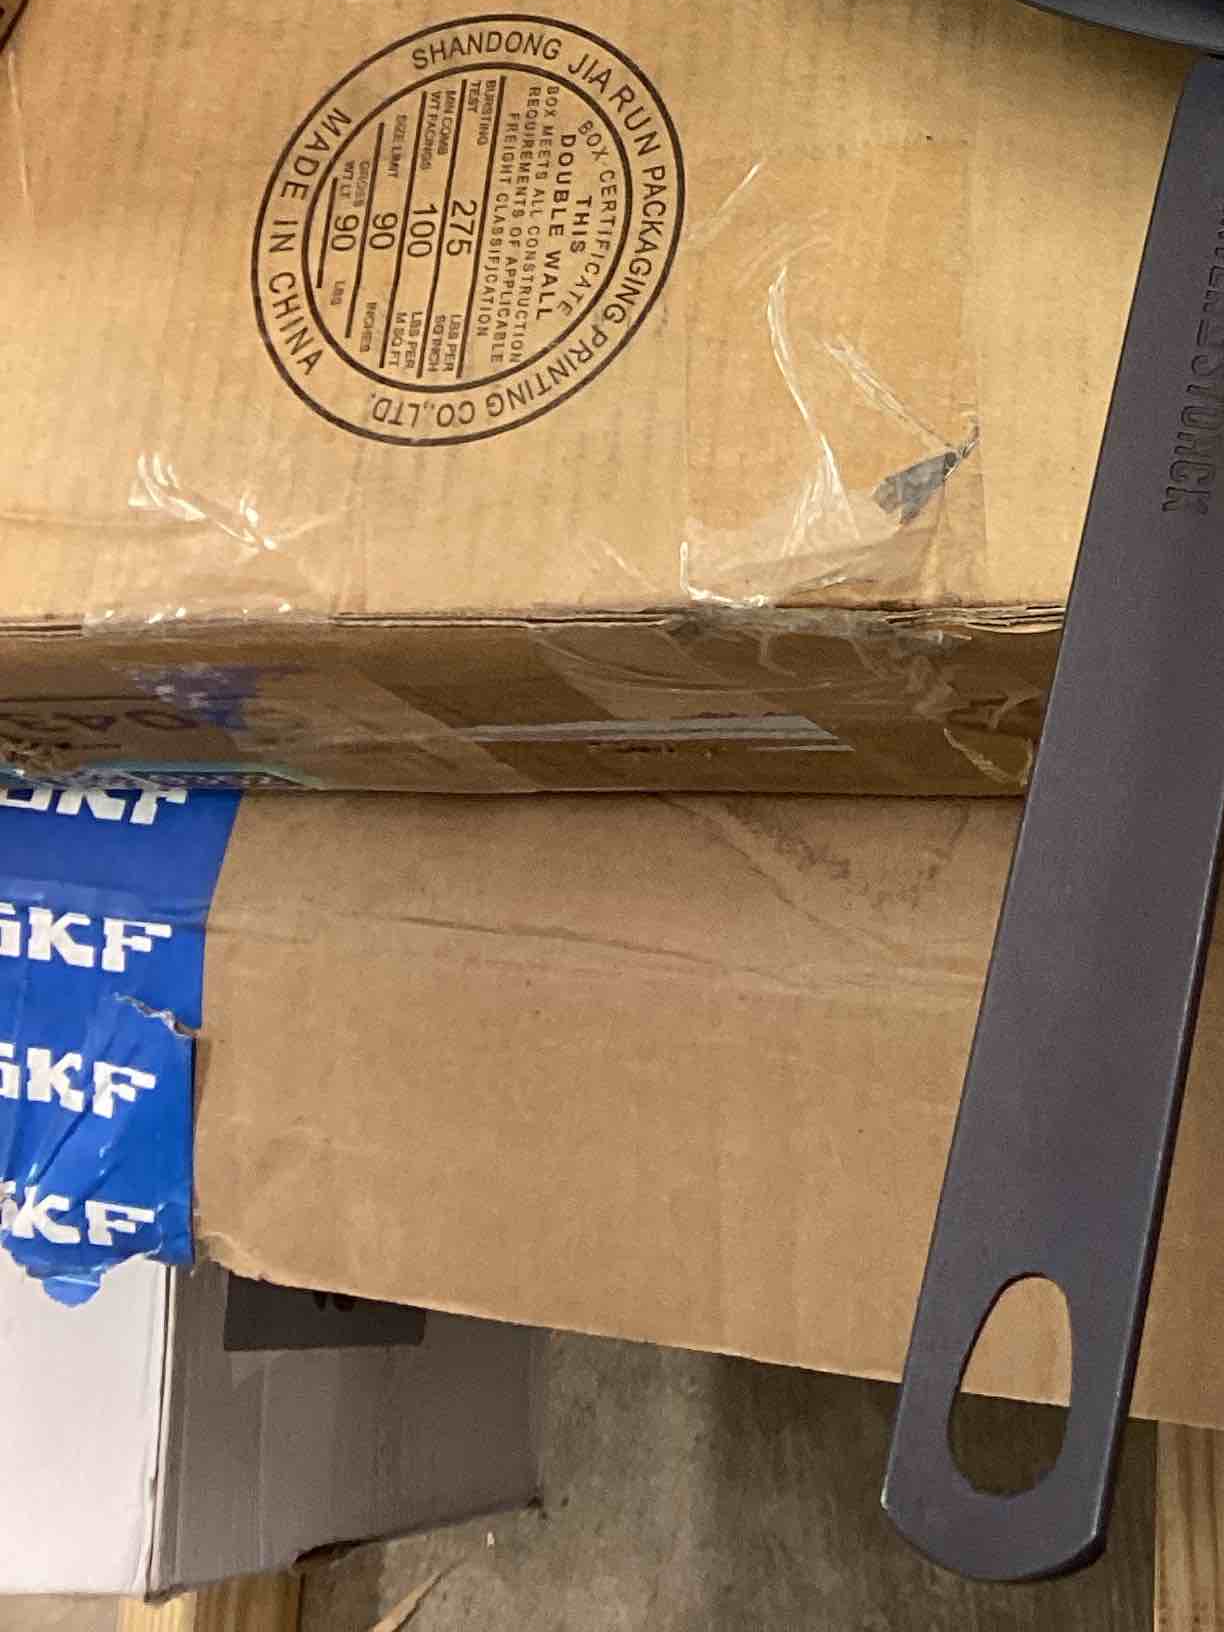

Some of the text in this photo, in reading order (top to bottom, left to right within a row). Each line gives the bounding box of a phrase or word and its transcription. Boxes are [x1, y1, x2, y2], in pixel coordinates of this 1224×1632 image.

[412, 31, 562, 70] SHANDONG
[467, 79, 482, 113] TEST
[476, 79, 497, 146] BURSTING
[499, 112, 521, 184] FREIGHT
[268, 107, 352, 377] MADE IN CHINA
[330, 214, 360, 252] 90
[369, 212, 398, 250] 90
[407, 203, 438, 258] 100
[446, 199, 478, 256] 275
[490, 86, 542, 363] REQUIREMENTS OF APPLICABLE
[509, 86, 560, 366] BOX MEETS ALL CONSTRUCTION
[536, 134, 577, 320] DOUBLE WALL
[556, 121, 618, 317] BOX CERTIFICATE
[569, 195, 593, 253] THIS
[603, 164, 668, 326] PACKAGING
[403, 311, 423, 370] LBS PER
[442, 314, 462, 372] LBS PER
[486, 325, 609, 418] PRINTING
[0, 1179, 155, 1247] KF
